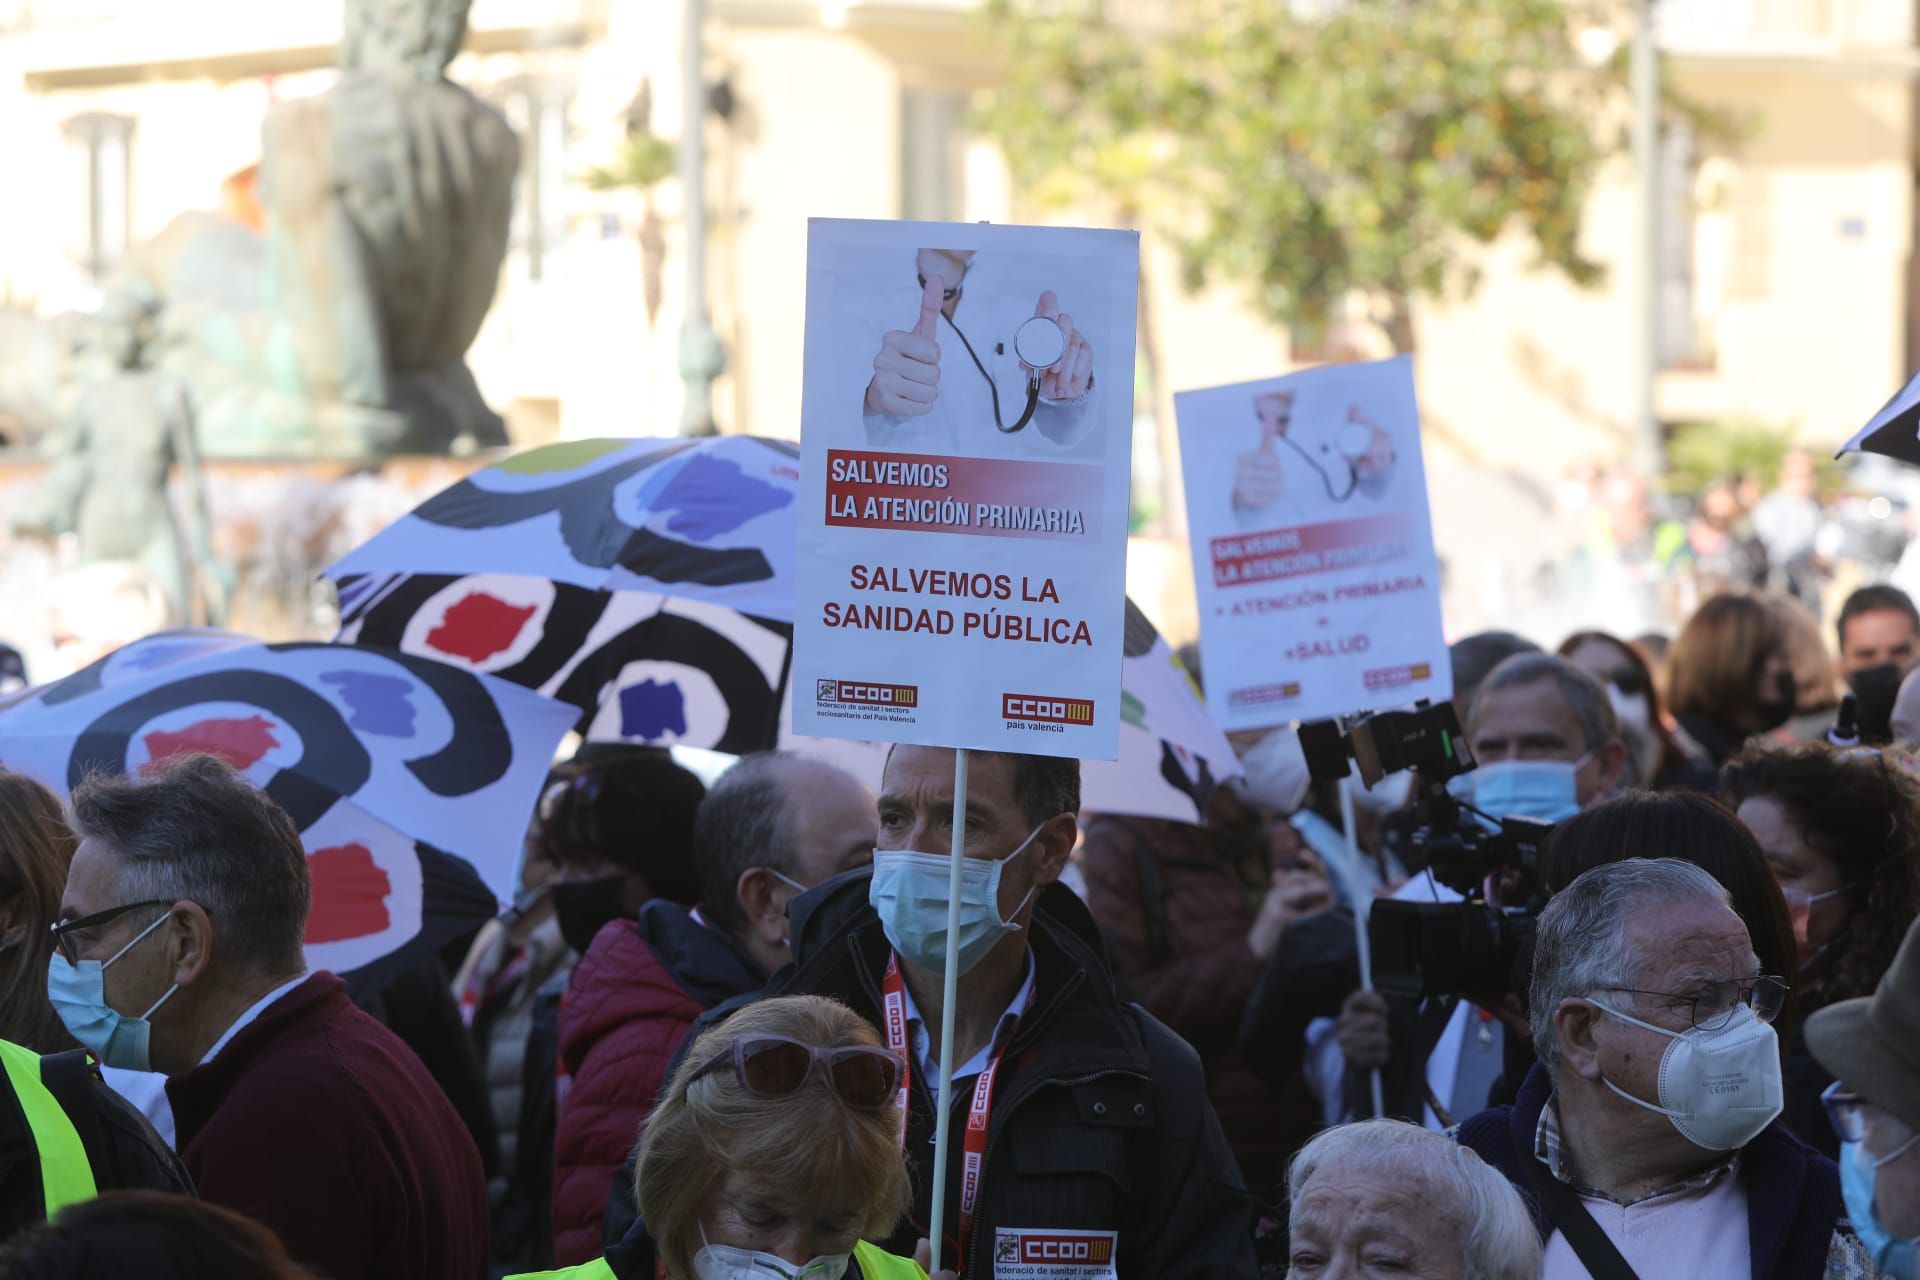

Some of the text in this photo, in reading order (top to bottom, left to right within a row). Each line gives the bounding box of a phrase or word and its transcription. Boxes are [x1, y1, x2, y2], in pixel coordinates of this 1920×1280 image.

[832, 458, 949, 488] SALVEMOS
[830, 494, 1085, 534] LA ATENCIÓN PRIMARIA
[850, 564, 1060, 604] SALVEMOS LA
[1333, 575, 1427, 602] PRIMARIA
[822, 602, 1093, 646] SANIDAD PÚBLICA
[841, 685, 893, 702] CCOO
[858, 704, 880, 712] sanitat
[1007, 698, 1066, 719] CCOO
[890, 1007, 902, 1045] CCOO
[975, 1072, 991, 1110] CCOO
[963, 1171, 976, 1210] CCOO
[1026, 1241, 1089, 1259] CCOO
[1037, 1265, 1048, 1275] de
[1049, 1267, 1077, 1276] sanitat
[1083, 1267, 1112, 1276] sectors
